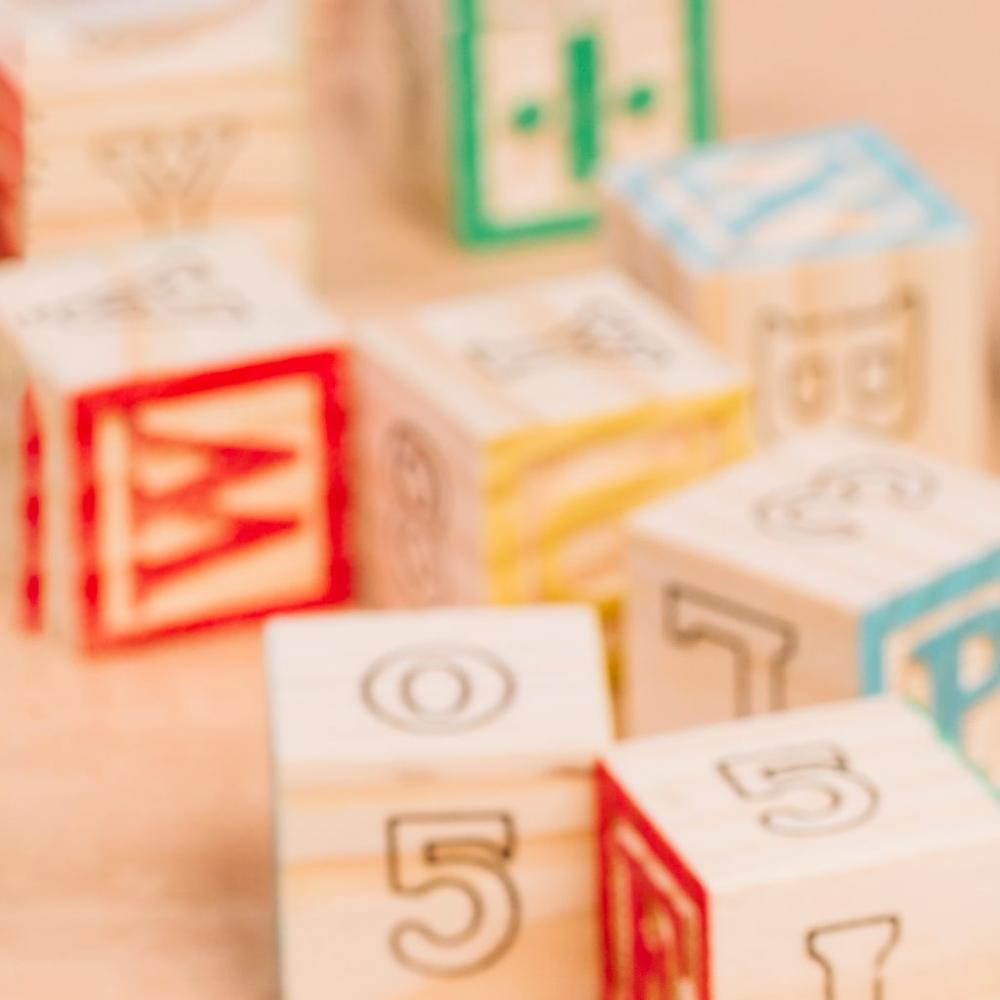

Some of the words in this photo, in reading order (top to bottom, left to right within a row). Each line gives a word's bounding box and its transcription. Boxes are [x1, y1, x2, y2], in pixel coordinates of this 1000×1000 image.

[130, 398, 300, 594] W
[717, 742, 879, 836] 5
[386, 810, 523, 978] 5
